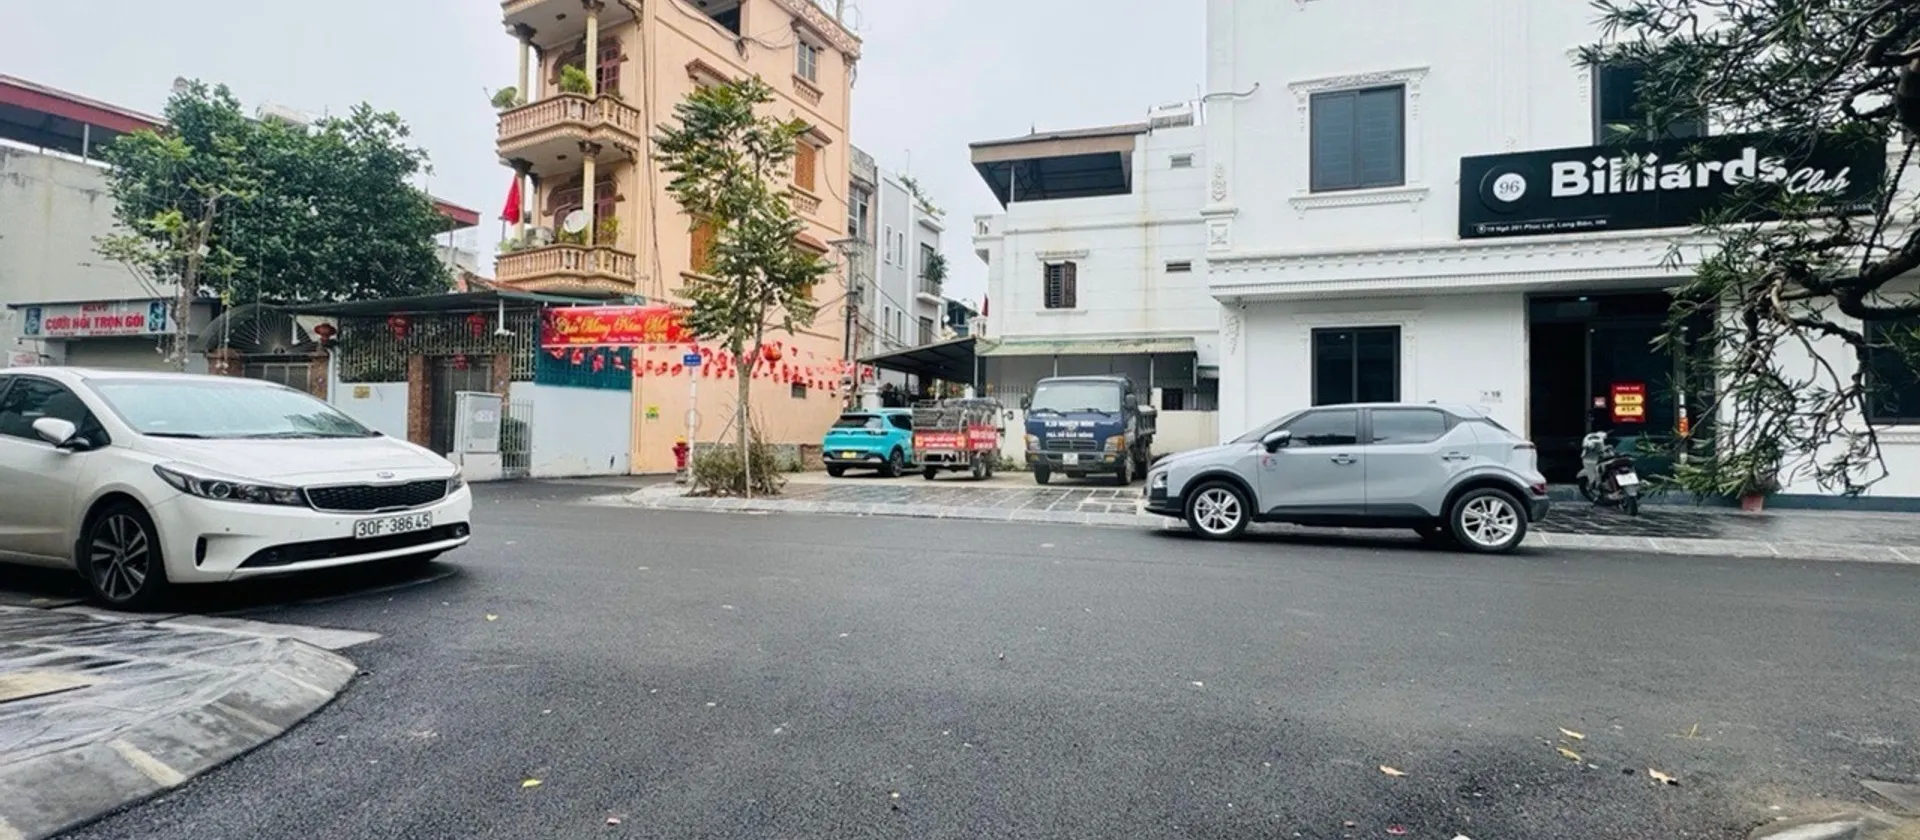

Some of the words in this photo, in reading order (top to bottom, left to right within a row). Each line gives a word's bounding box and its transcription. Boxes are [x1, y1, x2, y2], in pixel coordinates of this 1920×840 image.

[1552, 147, 1788, 198] Billiards
[1499, 181, 1521, 195] 96
[357, 514, 430, 537] 30F-386.45
